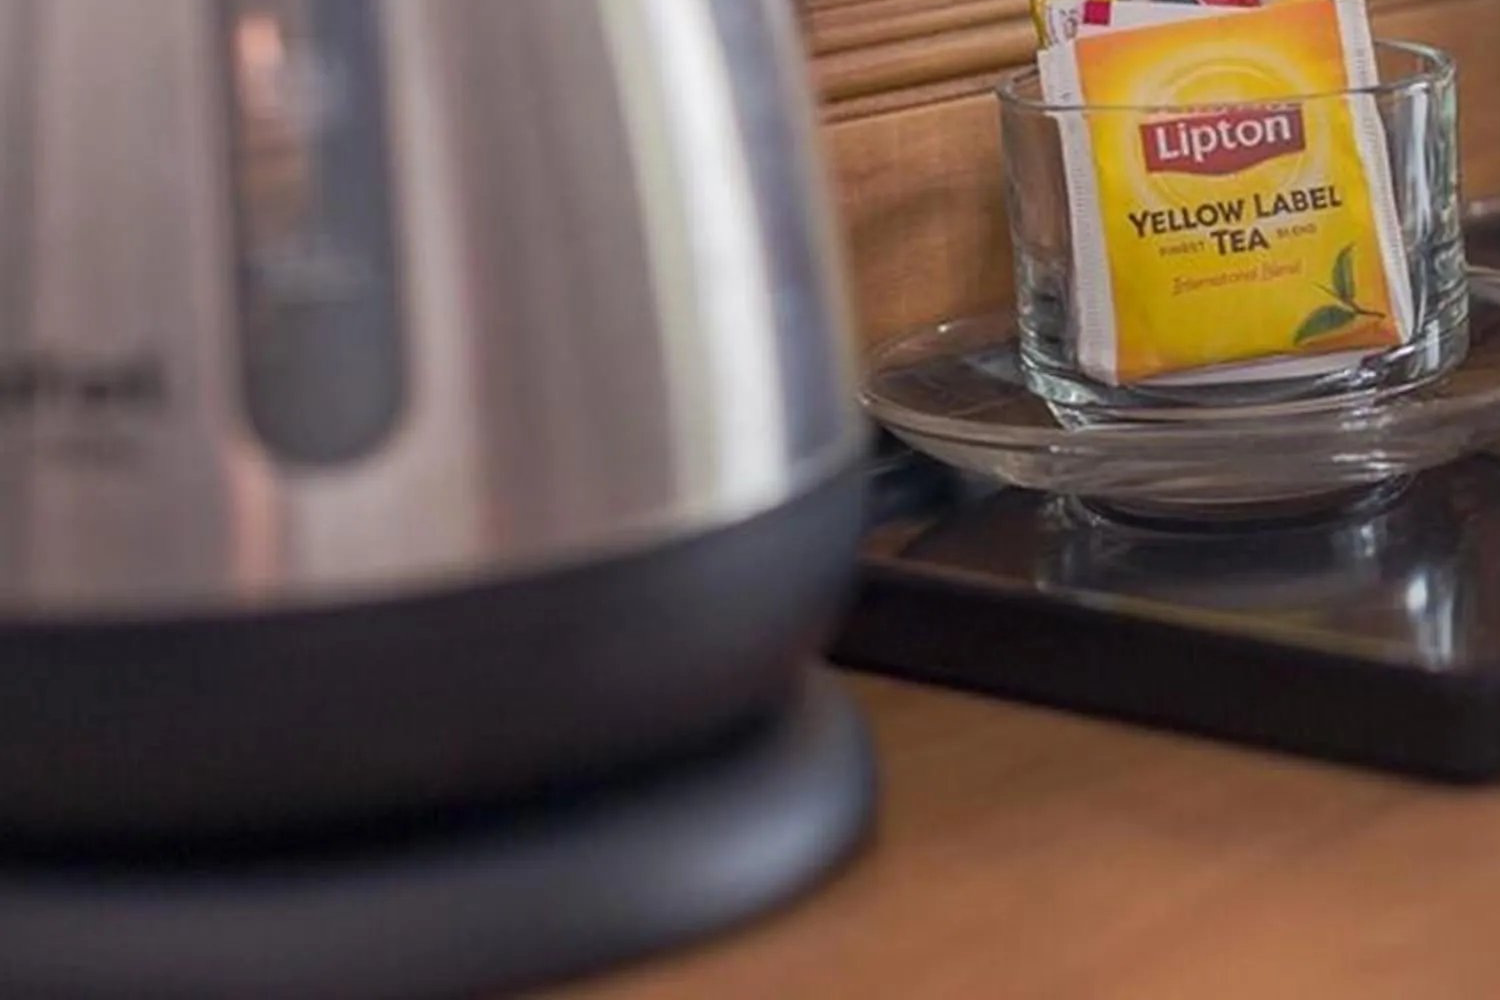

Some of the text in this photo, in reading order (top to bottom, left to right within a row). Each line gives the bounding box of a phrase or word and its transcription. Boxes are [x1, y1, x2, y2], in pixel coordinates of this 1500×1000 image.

[1155, 114, 1291, 162] Lipton
[1128, 184, 1343, 238] YELLOW LABEL
[1209, 226, 1271, 256] TEA
